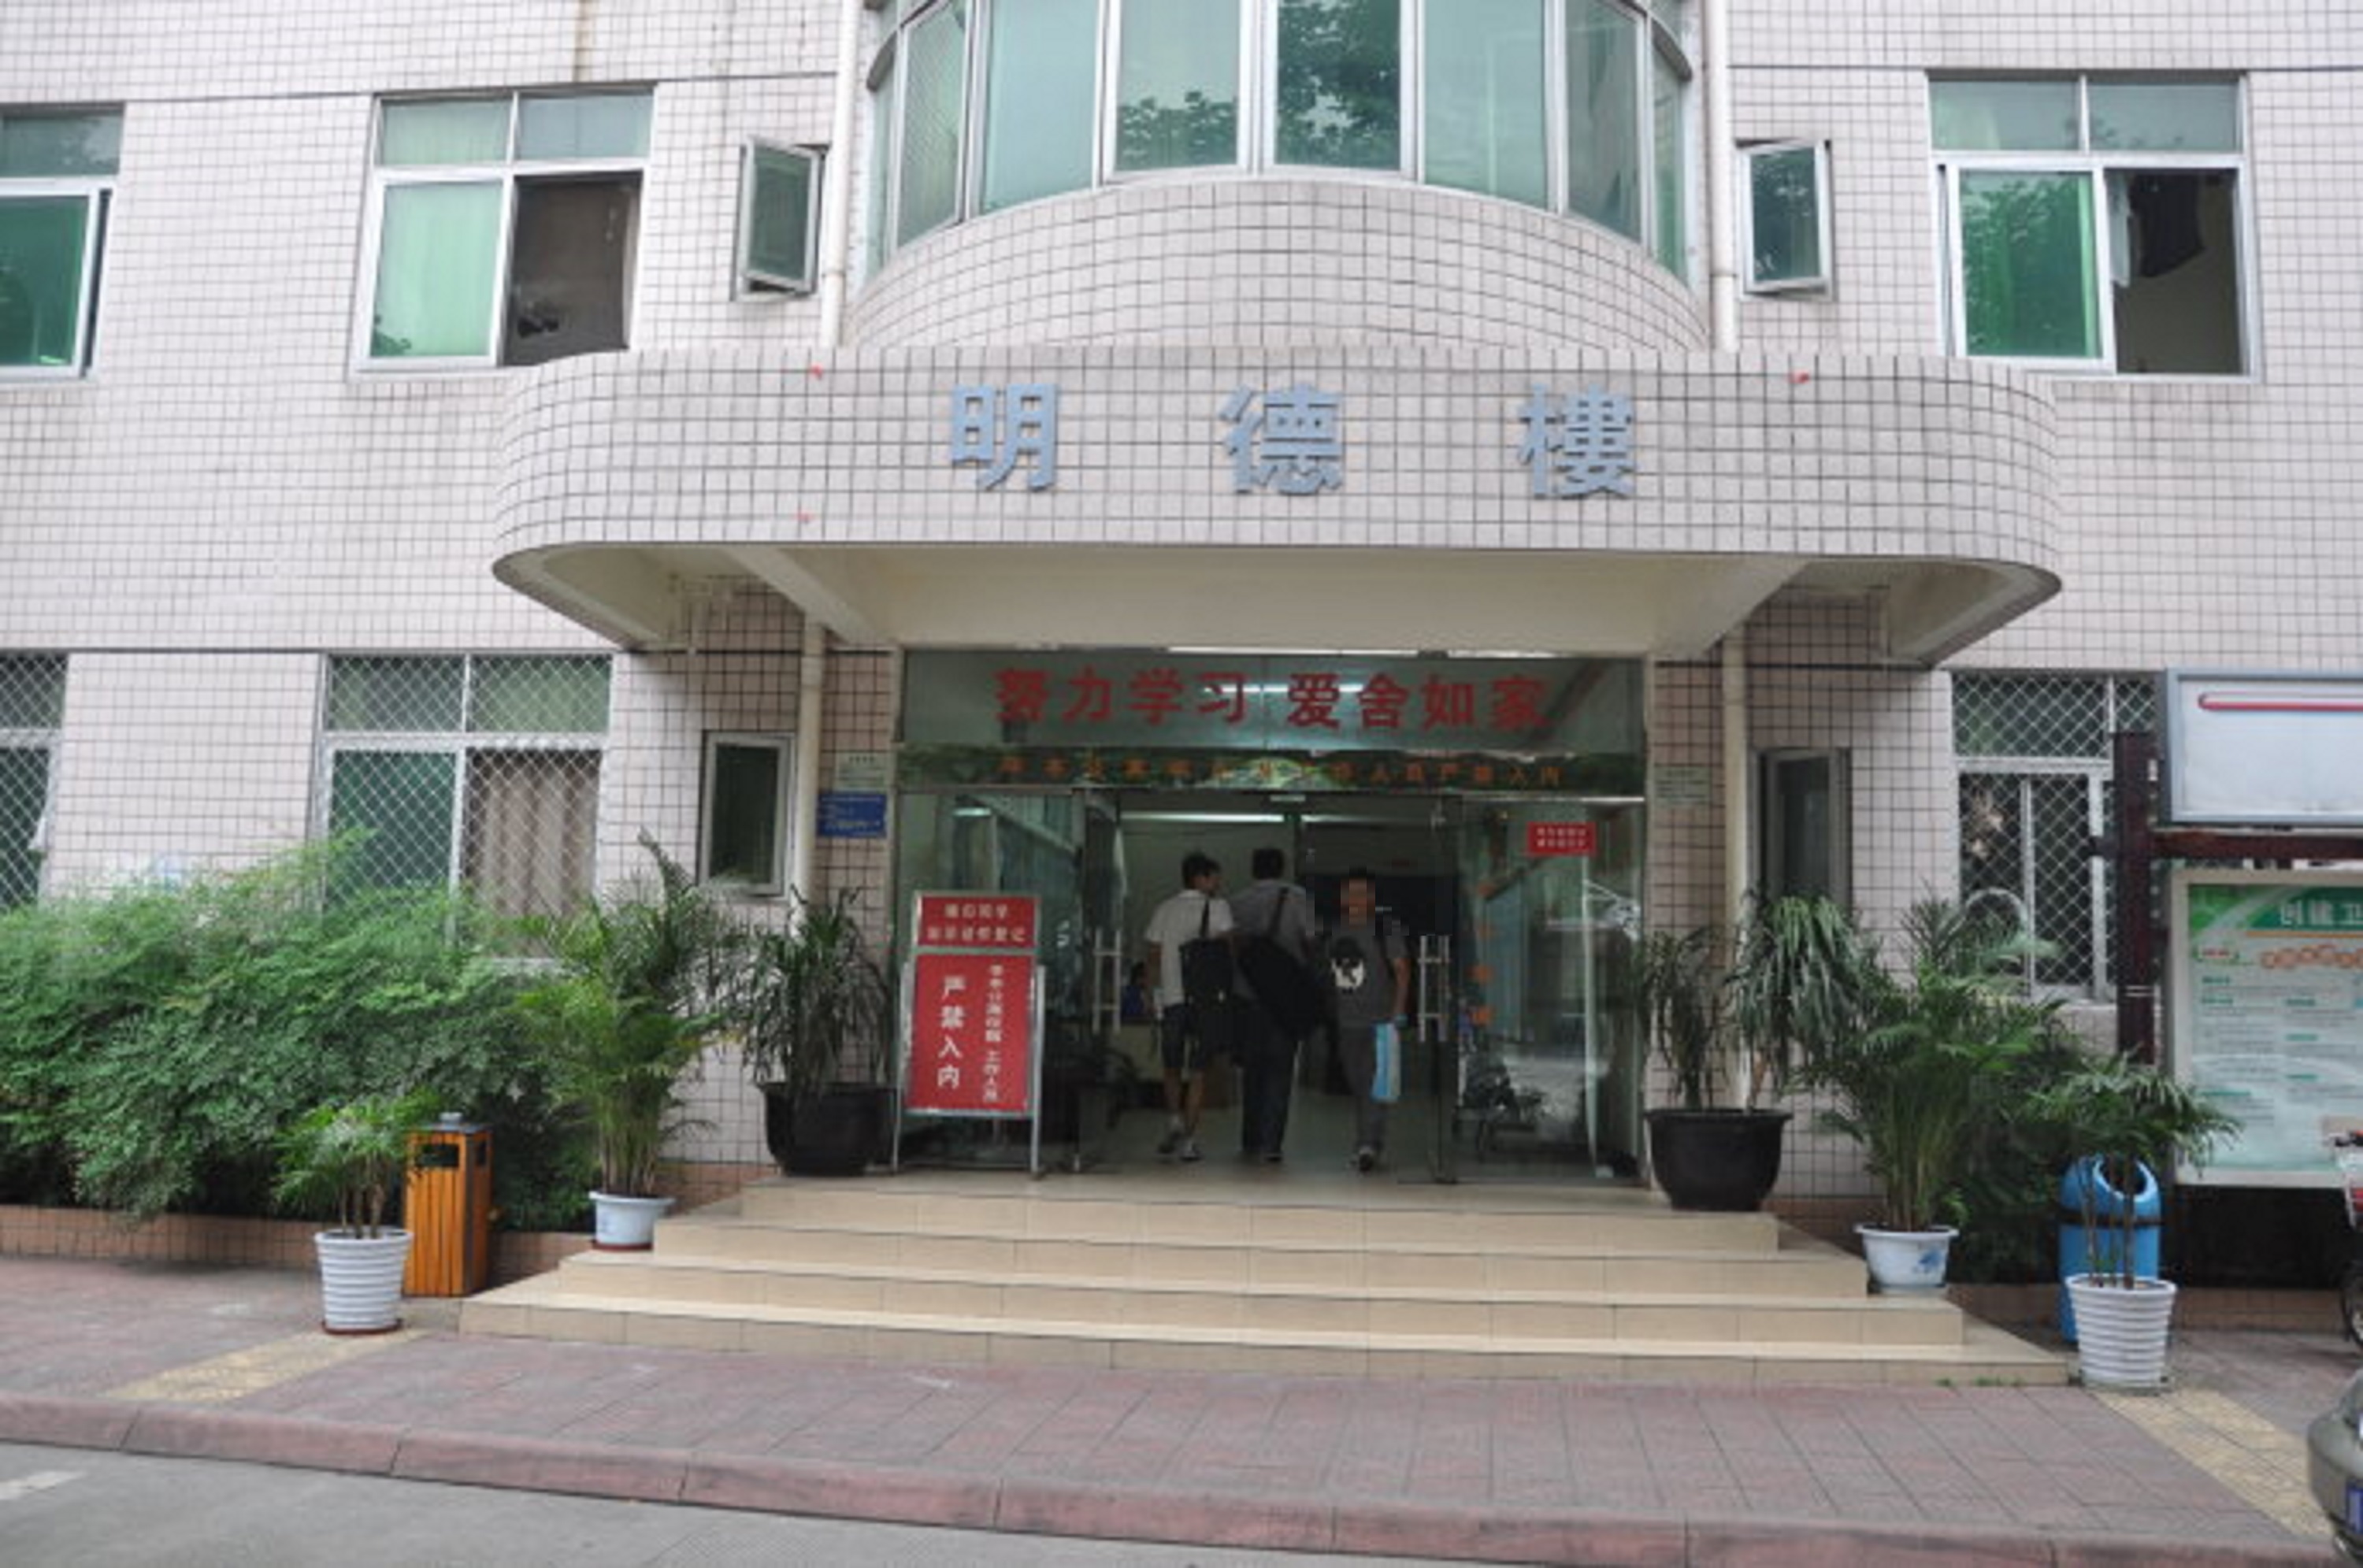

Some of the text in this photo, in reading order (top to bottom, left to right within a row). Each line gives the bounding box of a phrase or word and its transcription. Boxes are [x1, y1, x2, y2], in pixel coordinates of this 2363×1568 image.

[951, 383, 1636, 499] 明德樓
[995, 668, 1553, 731] 努力学习 爱舍如家
[937, 977, 966, 1089] 严禁入内
